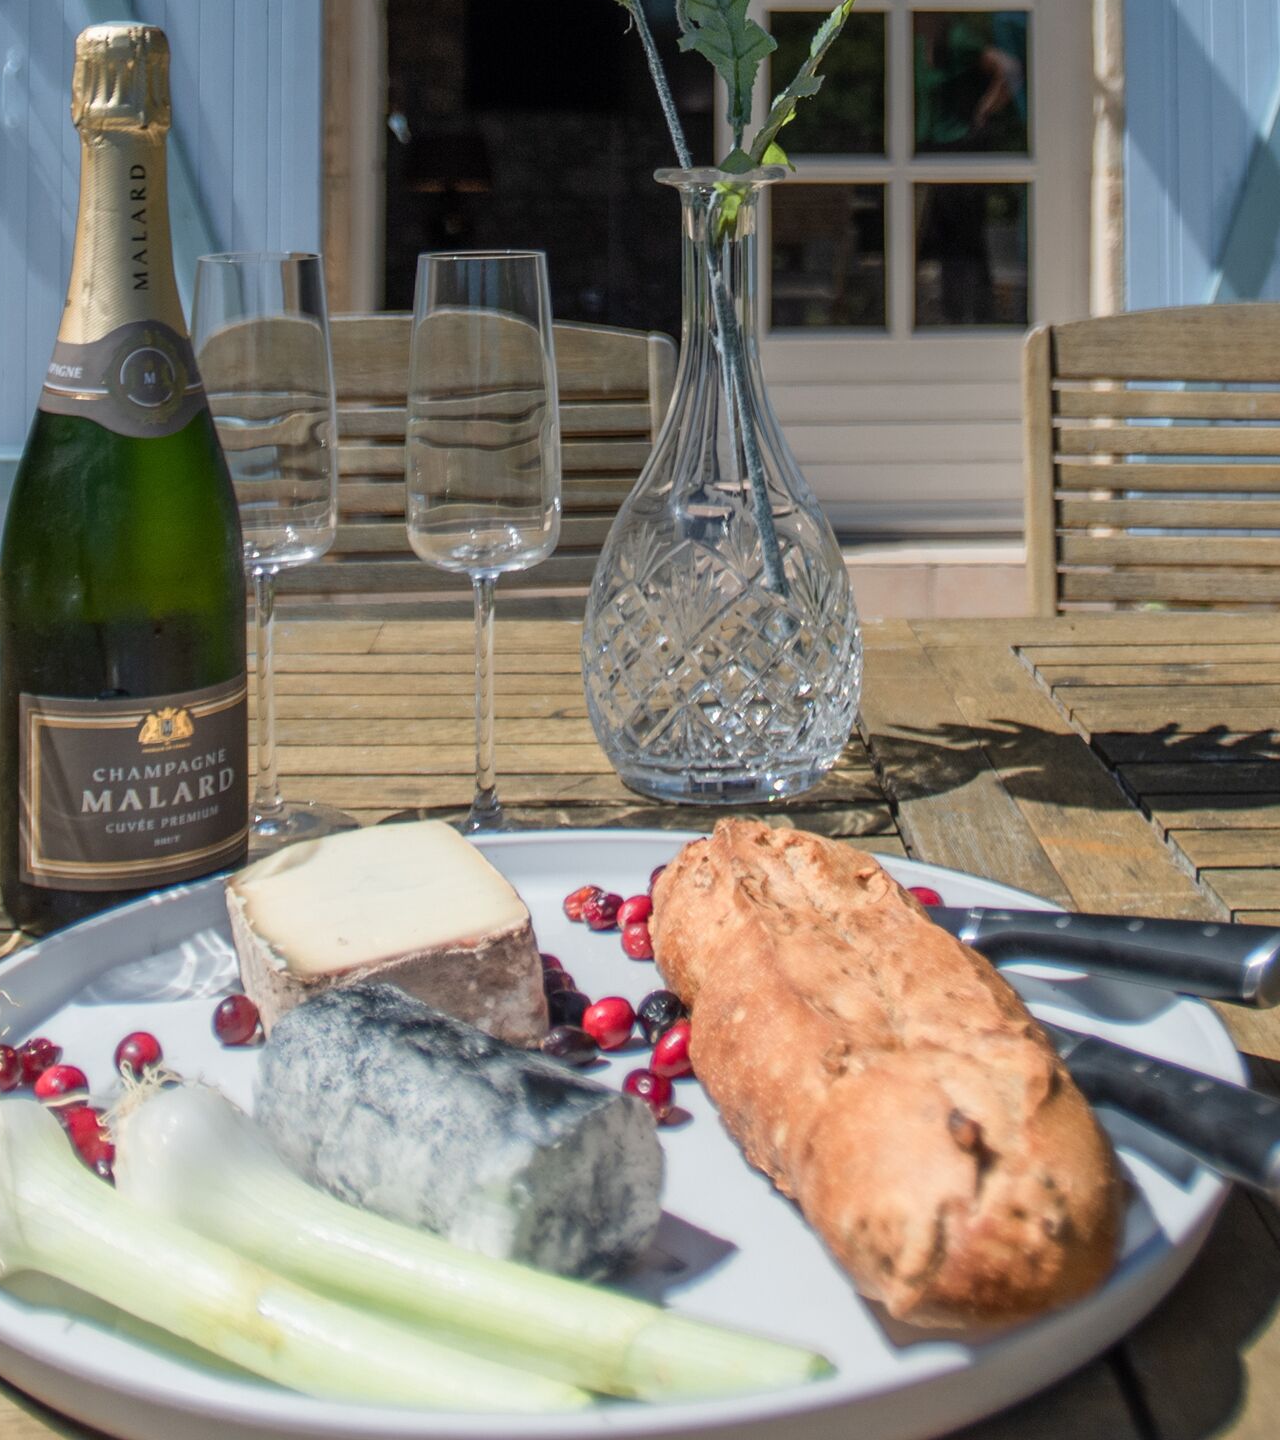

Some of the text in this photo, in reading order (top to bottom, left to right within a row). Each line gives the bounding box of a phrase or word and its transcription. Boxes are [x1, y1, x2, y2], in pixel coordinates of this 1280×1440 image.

[130, 164, 150, 291] MALARD
[92, 748, 226, 782] CHAMPAGNE
[81, 767, 234, 812] MALARD
[105, 805, 218, 834] CUVÉE PREMIUM
